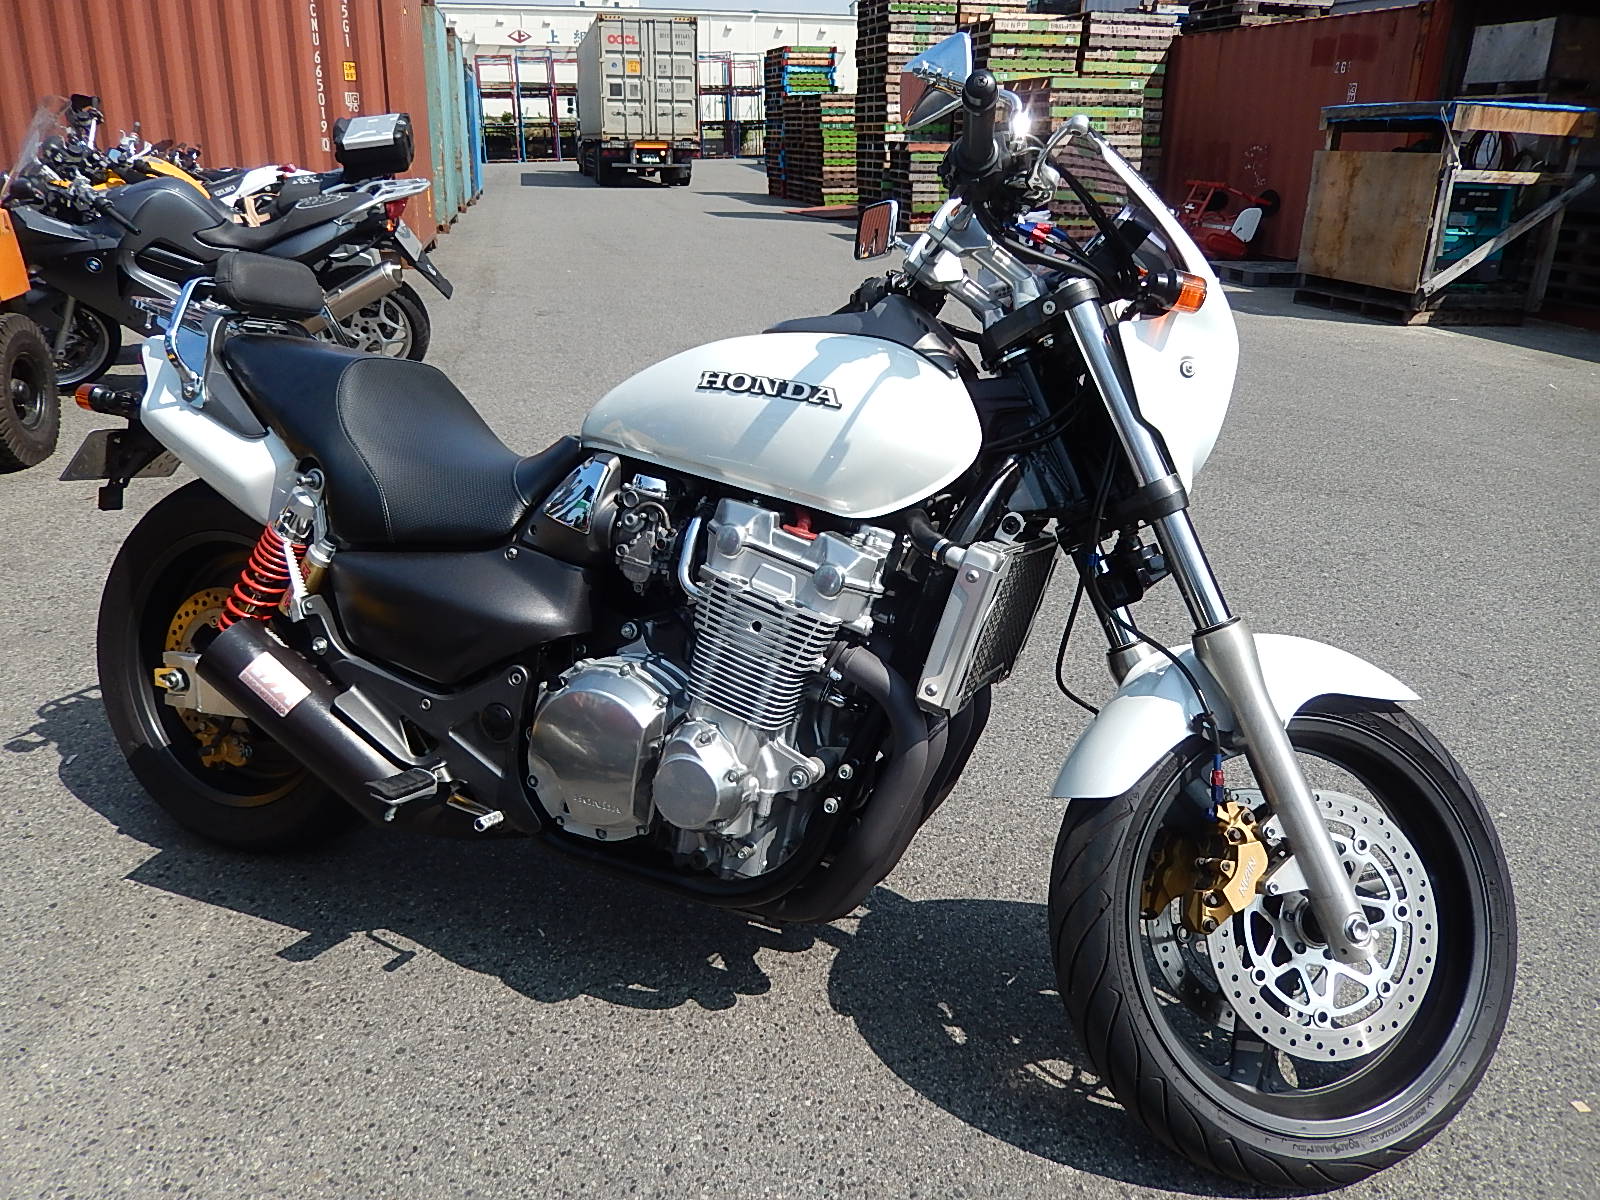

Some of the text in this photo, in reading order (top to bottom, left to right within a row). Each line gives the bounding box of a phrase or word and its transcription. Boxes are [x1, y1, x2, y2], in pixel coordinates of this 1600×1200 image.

[309, 0, 320, 46] CNU
[341, 0, 350, 47] 5G1
[607, 34, 639, 45] OOCL
[314, 50, 328, 133] 665019
[697, 370, 842, 409] HONDA
[573, 796, 622, 814] HONDA
